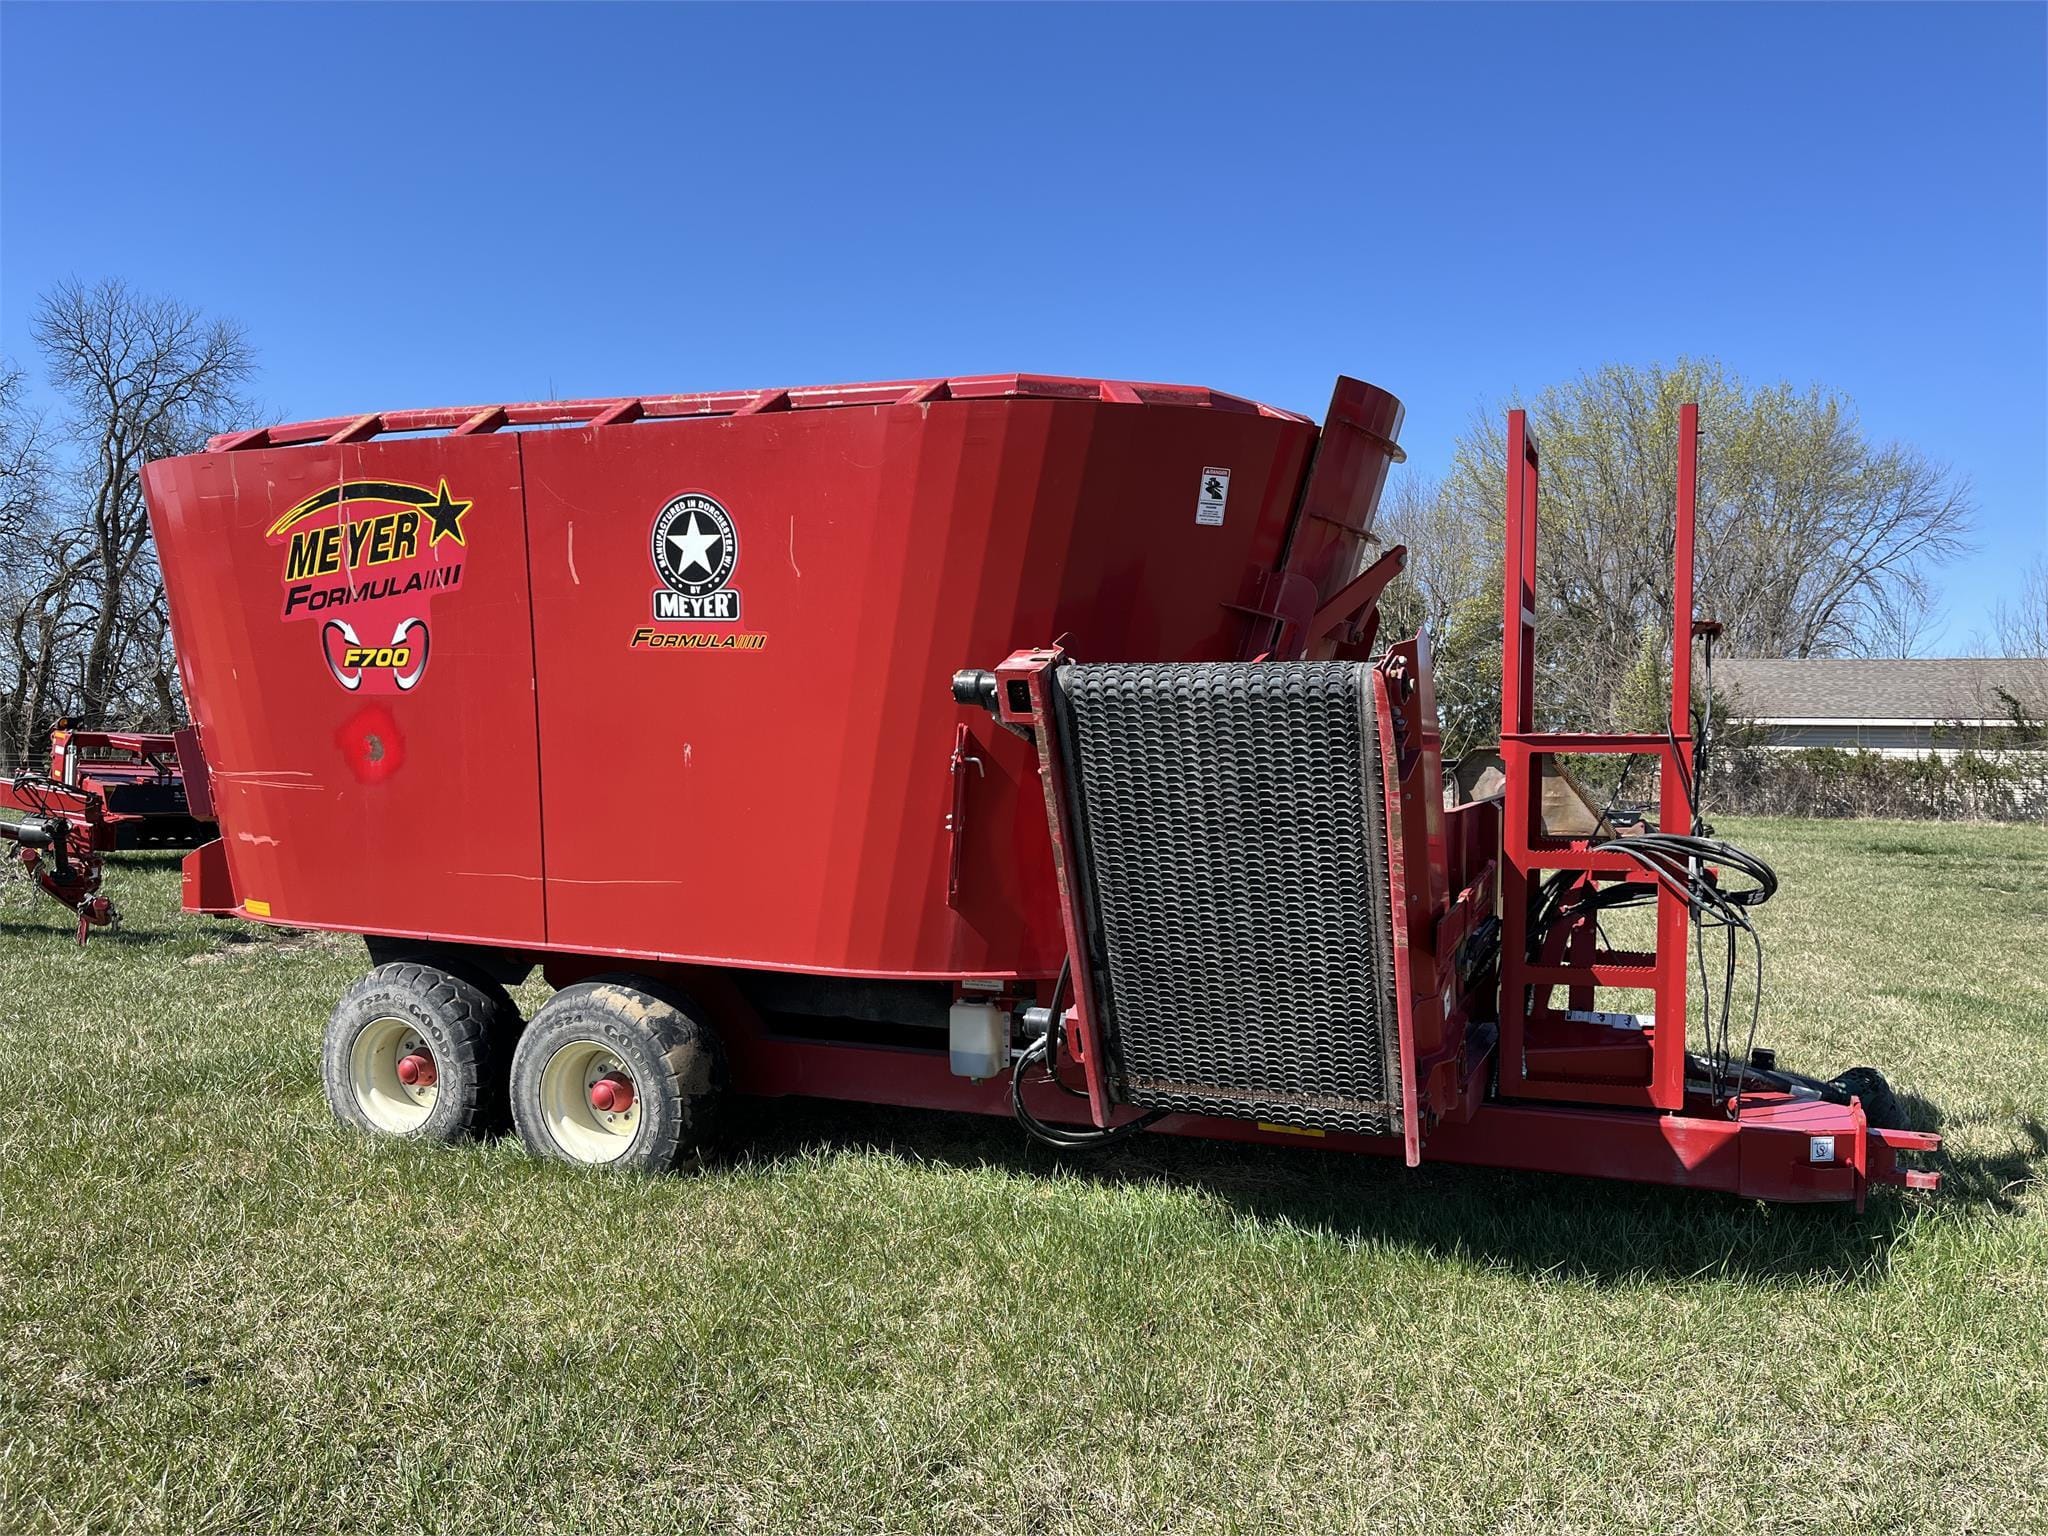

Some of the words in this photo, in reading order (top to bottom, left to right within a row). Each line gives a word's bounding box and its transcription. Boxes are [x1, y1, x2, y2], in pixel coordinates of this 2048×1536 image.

[284, 510, 421, 582] MEYER
[656, 501, 686, 569] MANUFACTURED
[687, 499, 696, 508] IN
[698, 500, 733, 552] DORCHESTER
[722, 555, 733, 568] WI
[660, 593, 729, 617] MEYER
[689, 586, 701, 594] BY
[343, 647, 411, 668] F700
[604, 1024, 662, 1156] GOODYEA
